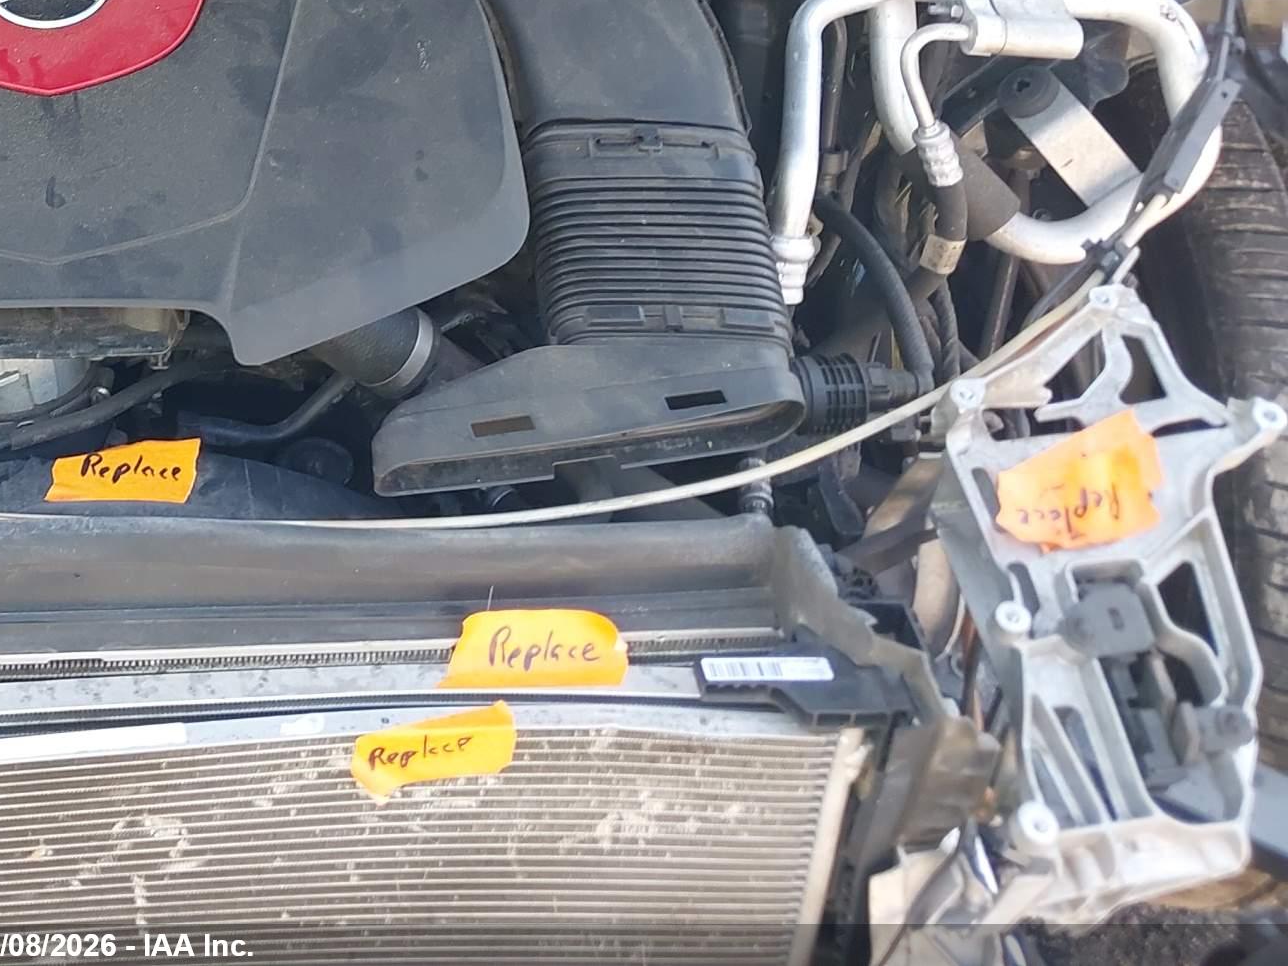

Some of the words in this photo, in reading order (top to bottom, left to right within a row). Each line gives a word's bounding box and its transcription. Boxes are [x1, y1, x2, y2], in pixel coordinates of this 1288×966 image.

[80, 453, 182, 484] Replace
[488, 625, 601, 672] Replace
[368, 734, 474, 771] Replace
